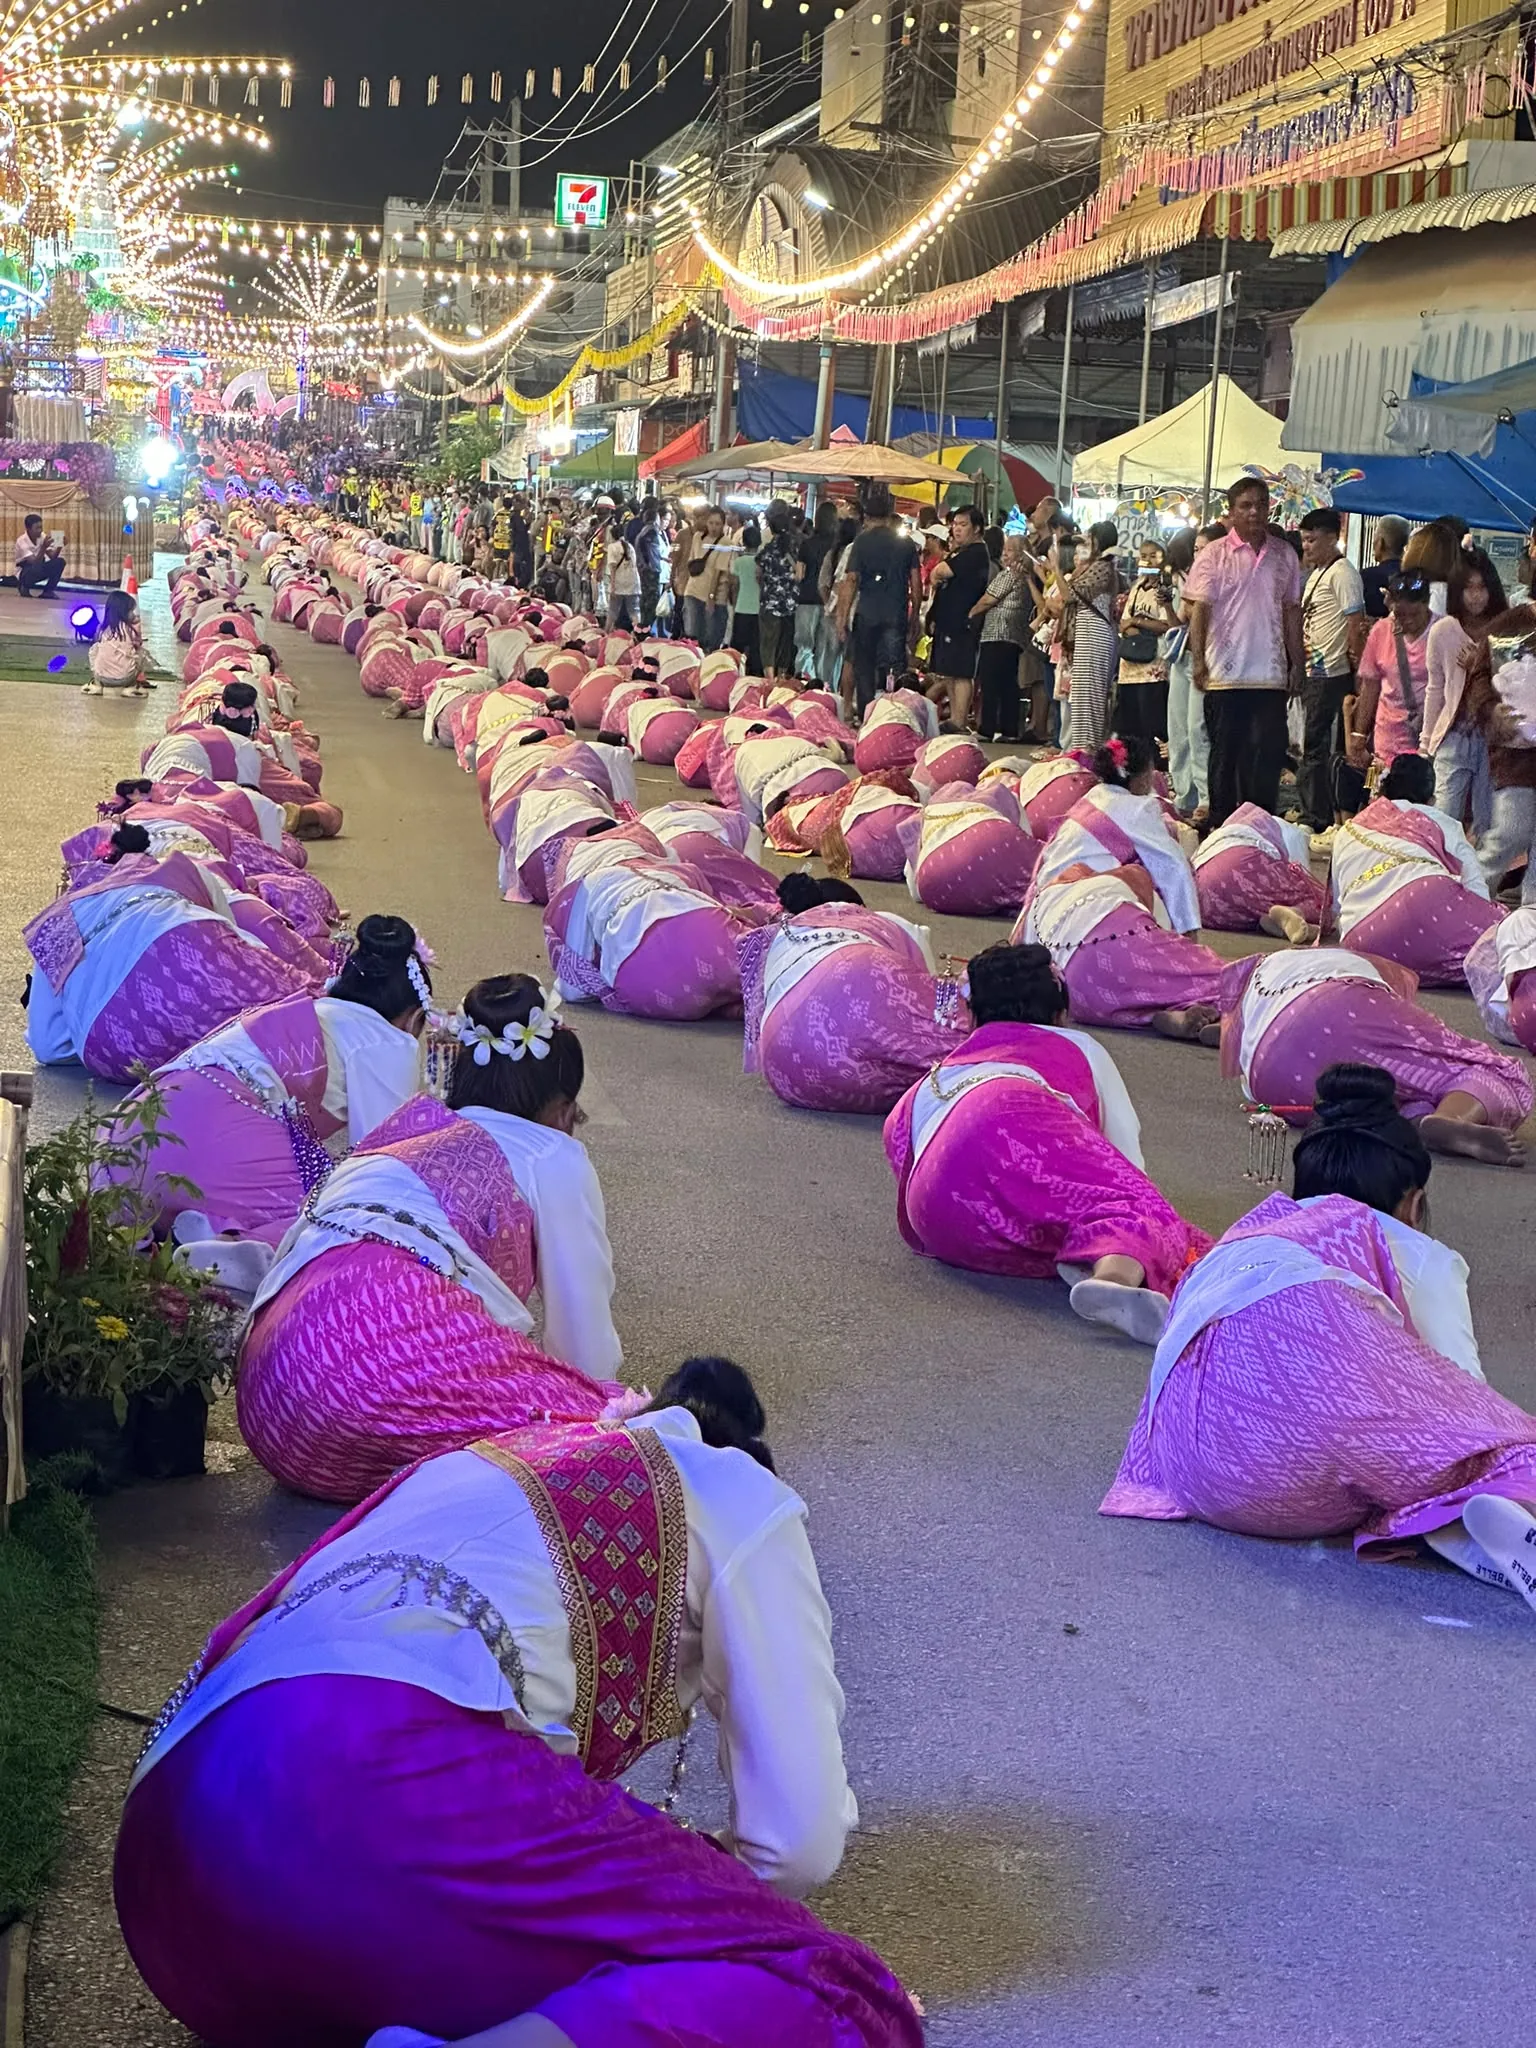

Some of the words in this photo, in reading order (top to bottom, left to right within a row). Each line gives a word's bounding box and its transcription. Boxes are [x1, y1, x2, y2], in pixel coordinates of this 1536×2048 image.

[1118, 530, 1145, 550] 20
[1475, 1564, 1505, 1583] BELLE
[1511, 1559, 1532, 1585] BELLE
